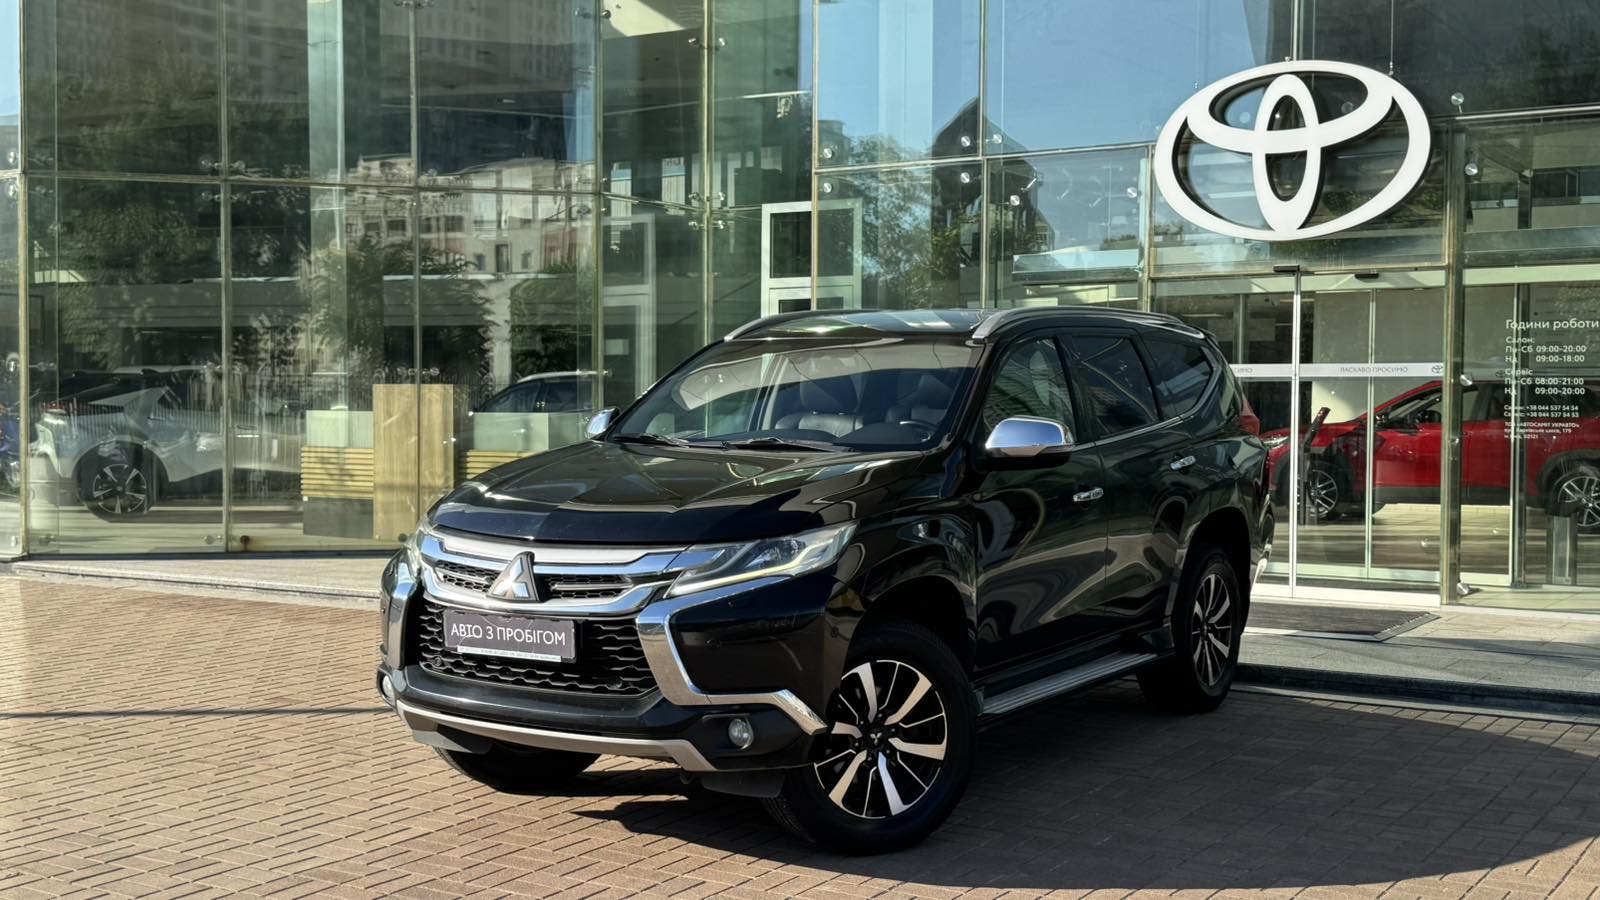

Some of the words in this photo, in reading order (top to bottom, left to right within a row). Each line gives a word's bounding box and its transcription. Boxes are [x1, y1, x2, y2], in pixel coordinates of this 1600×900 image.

[1505, 319, 1550, 331] Години
[1553, 317, 1599, 332] роботи
[1505, 336, 1536, 344] Салон:
[1535, 345, 1587, 353] 09:00-20:00
[1534, 377, 1585, 385] 08:00-21:00
[1534, 387, 1586, 395] 09:00-20:00
[450, 623, 483, 639] АВТО
[486, 626, 494, 640] З
[496, 627, 566, 646] ПРОБІГОМ
